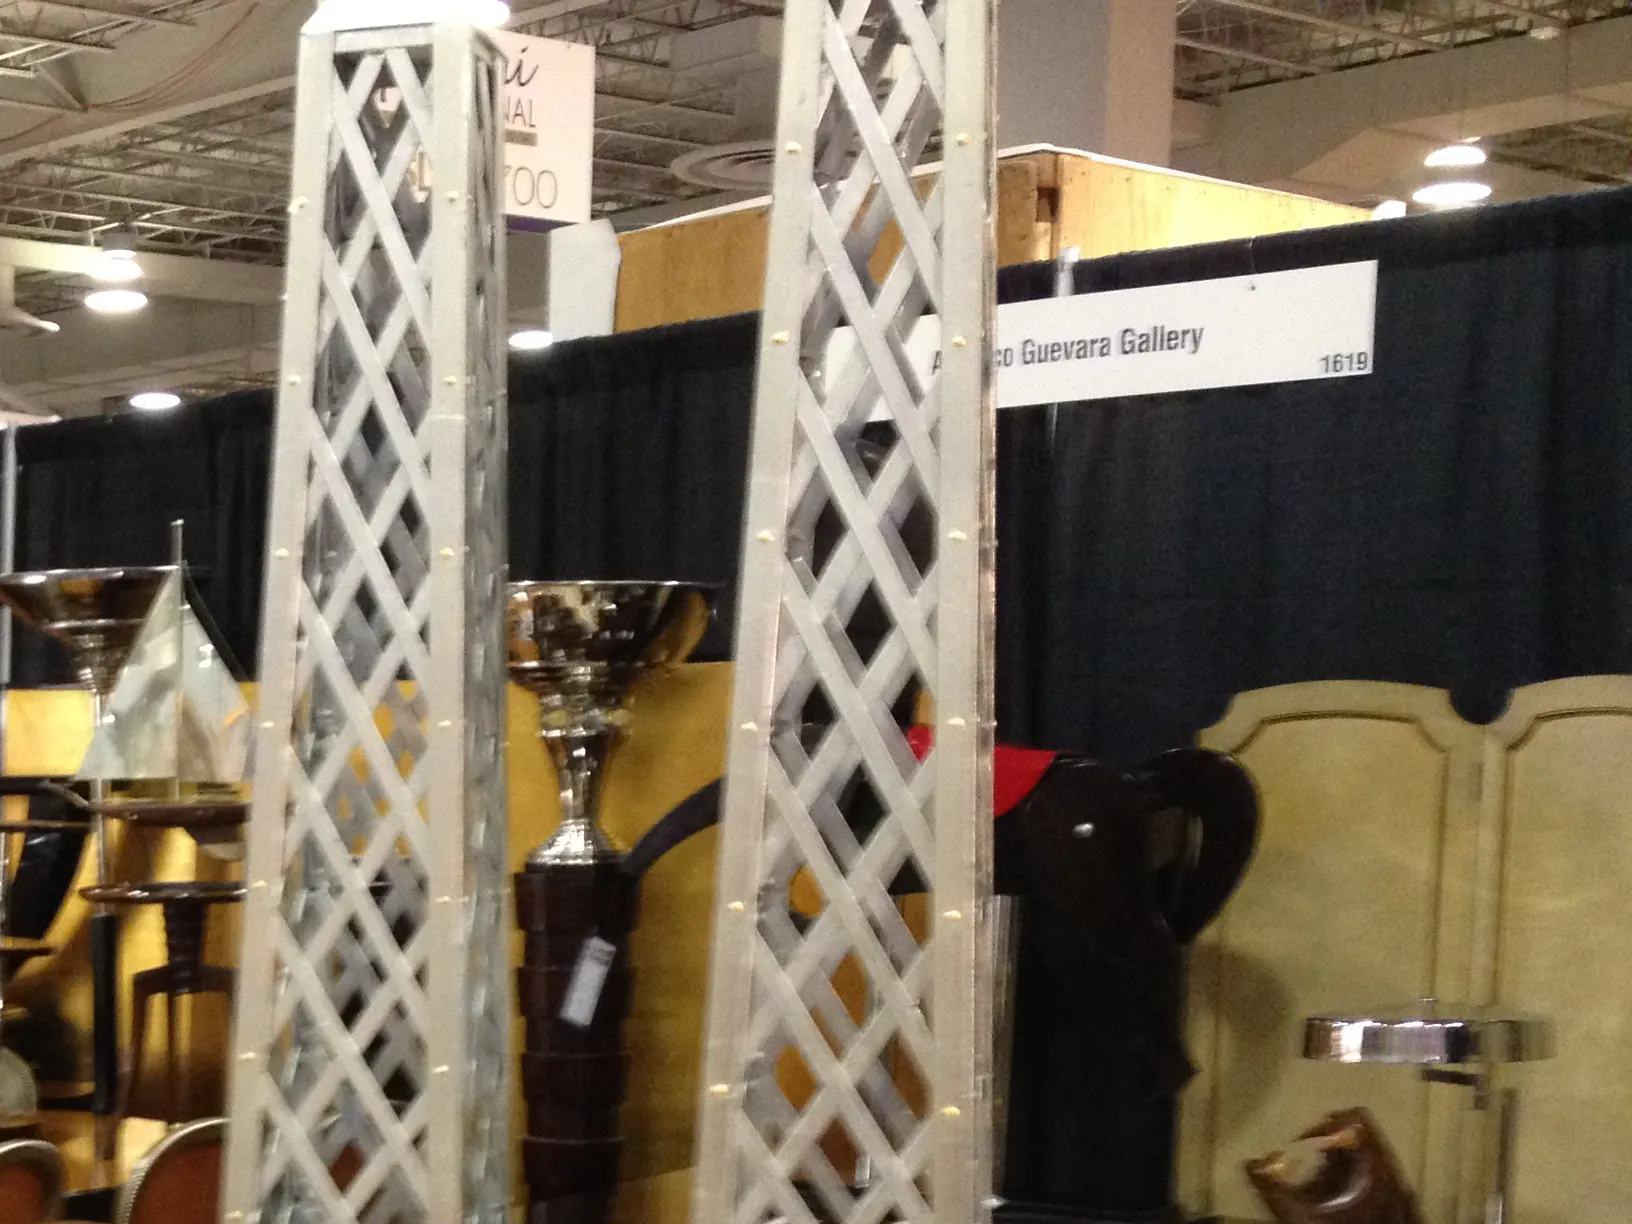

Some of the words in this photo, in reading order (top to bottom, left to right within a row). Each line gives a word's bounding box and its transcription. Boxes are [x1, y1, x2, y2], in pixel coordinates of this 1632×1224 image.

[1021, 338, 1112, 366] Guevara
[1120, 325, 1205, 354] Gallery
[1318, 351, 1369, 373] 1619
